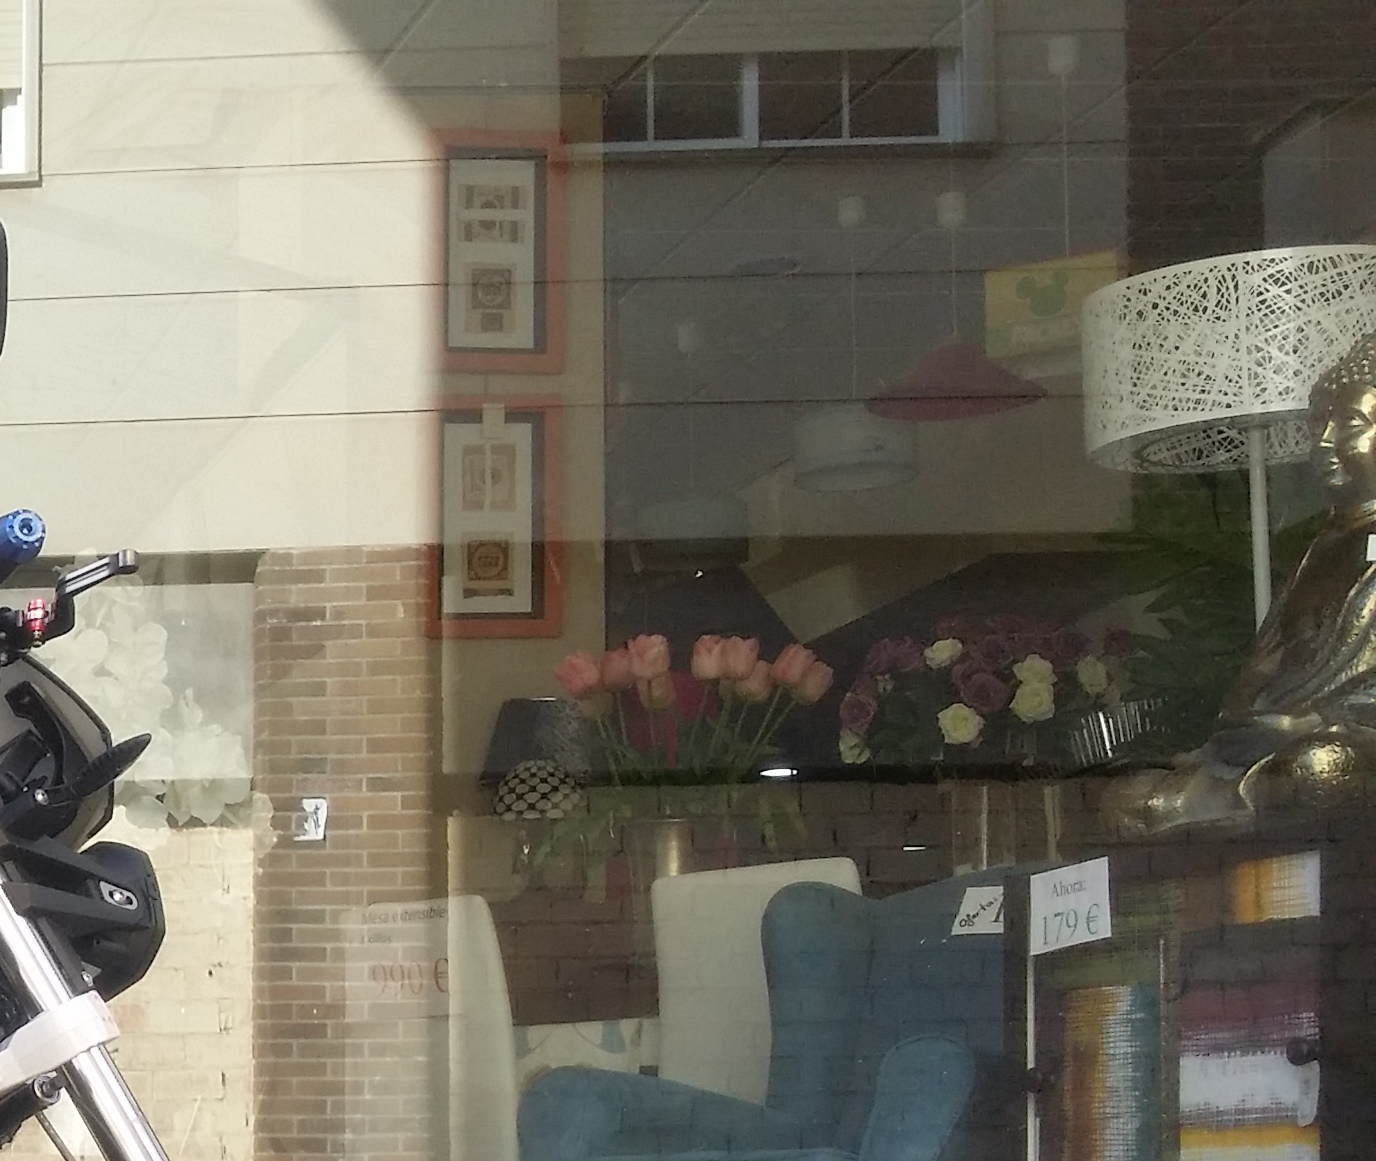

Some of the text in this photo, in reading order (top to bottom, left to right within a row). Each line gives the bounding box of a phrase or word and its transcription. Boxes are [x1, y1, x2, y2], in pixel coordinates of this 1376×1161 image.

[1051, 880, 1087, 899] Ahora:
[1042, 903, 1100, 946] 179 €
